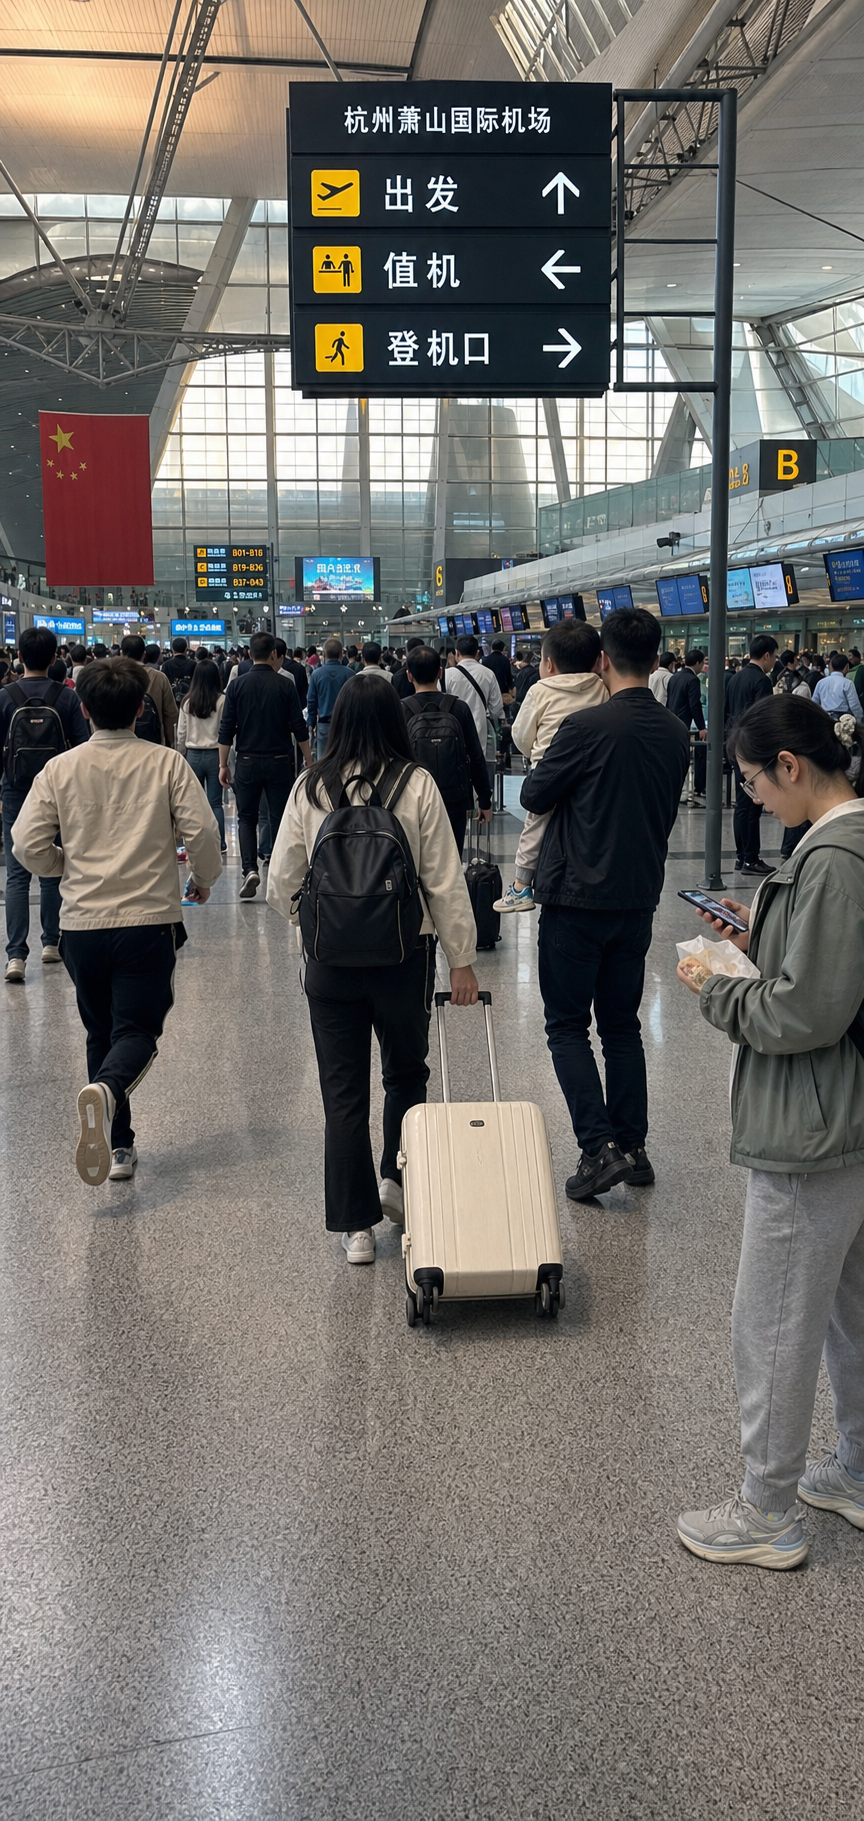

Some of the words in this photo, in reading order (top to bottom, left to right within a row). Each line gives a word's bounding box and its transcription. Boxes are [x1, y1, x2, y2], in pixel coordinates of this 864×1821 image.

[344, 106, 551, 134] 杭州萧山国际机场
[384, 174, 459, 213] 出发
[383, 252, 461, 290] 值机
[387, 330, 490, 367] 登机口
[777, 449, 800, 480] B
[436, 566, 443, 587] 6
